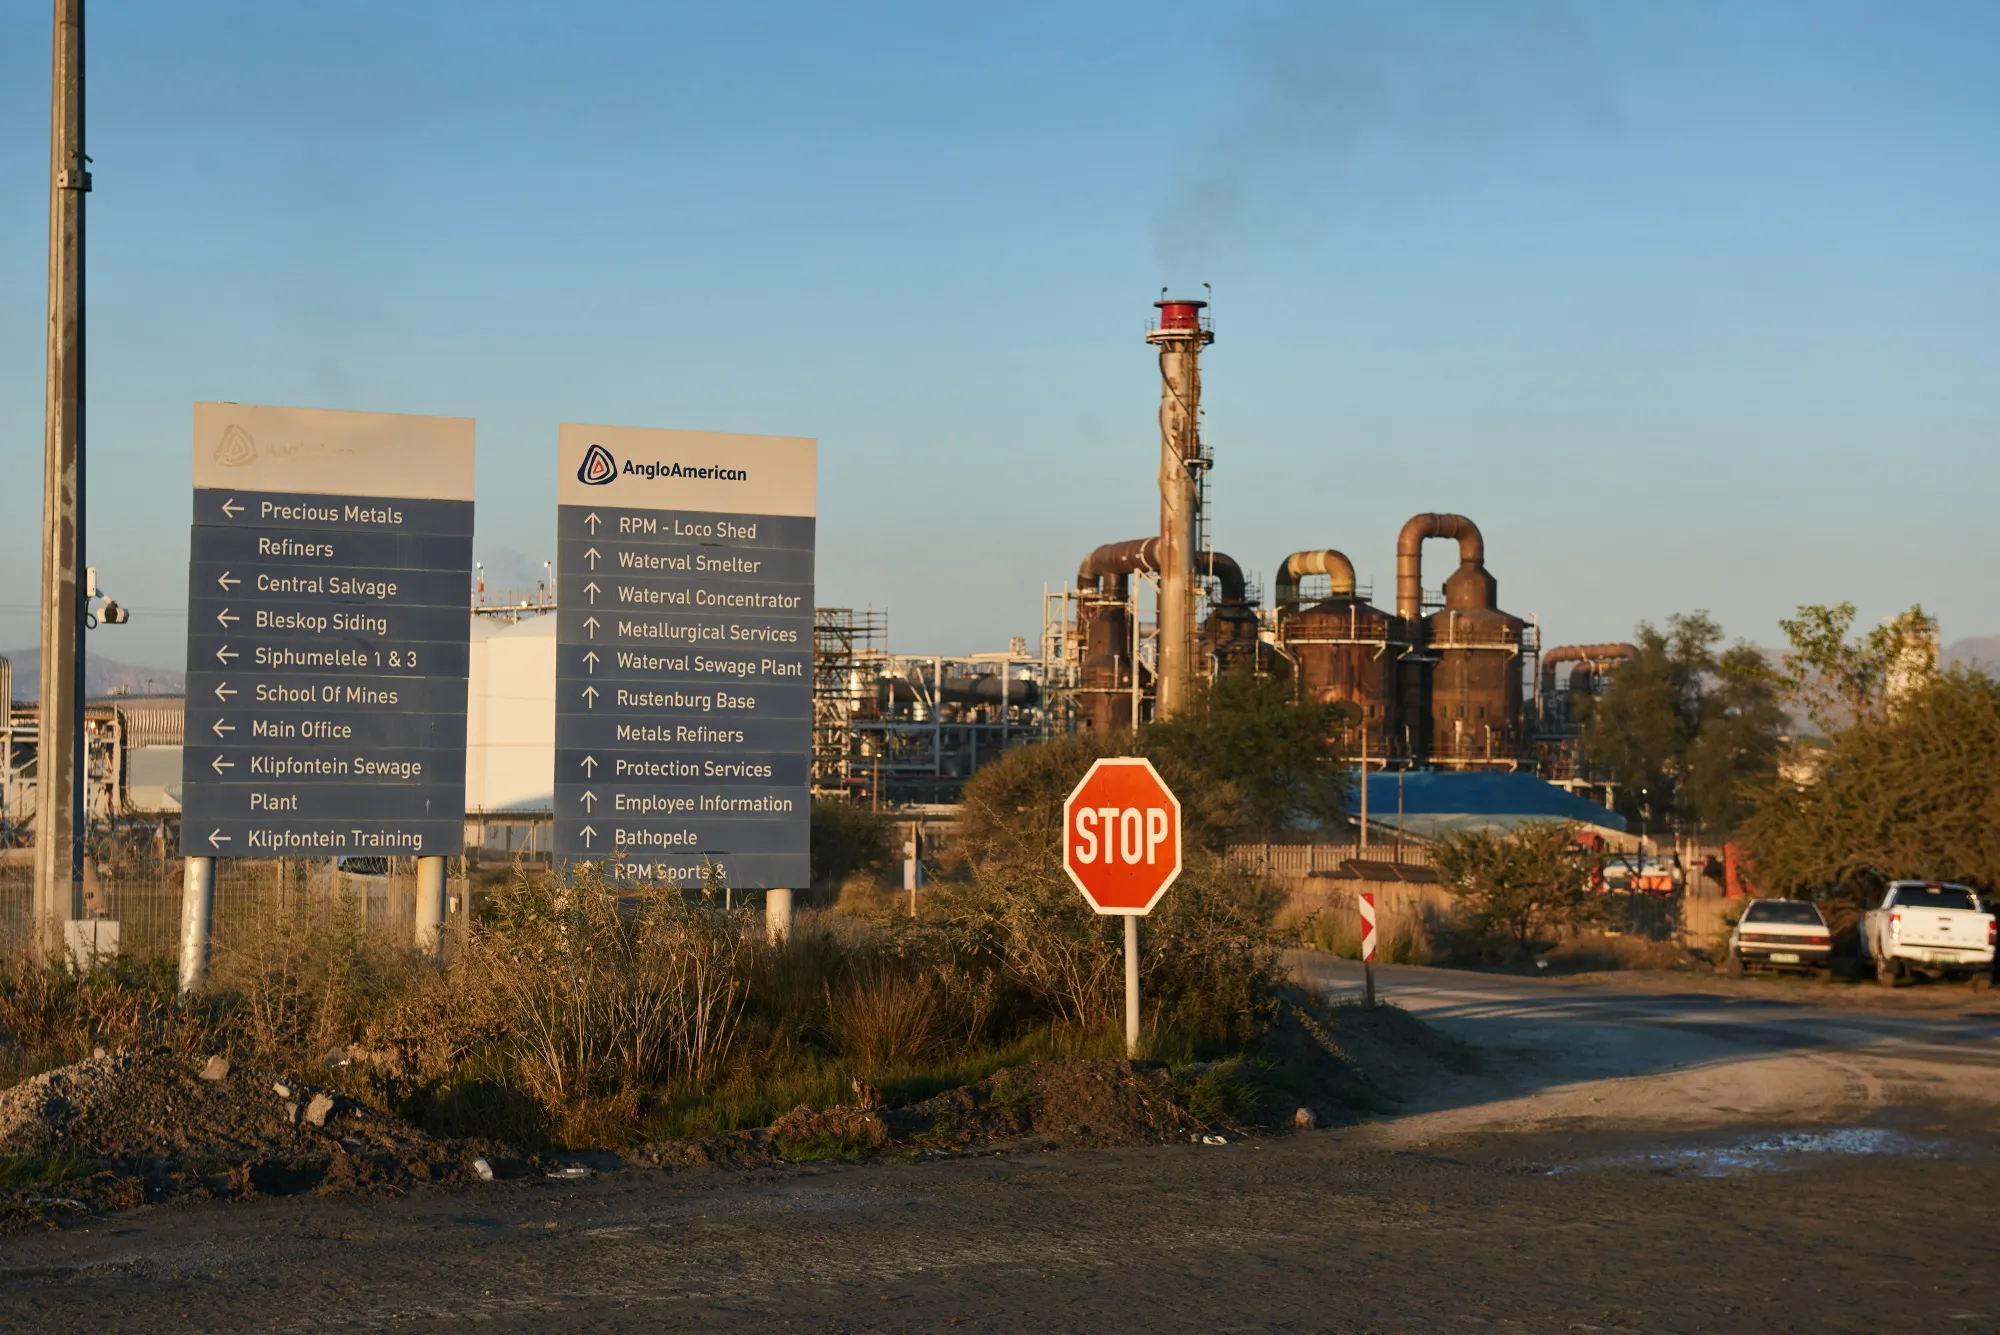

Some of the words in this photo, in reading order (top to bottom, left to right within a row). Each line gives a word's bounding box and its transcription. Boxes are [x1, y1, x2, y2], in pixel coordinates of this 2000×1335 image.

[623, 460, 746, 481] AngloAmerican
[262, 502, 338, 521] Precious
[345, 505, 402, 524] Metals
[620, 517, 656, 534] RPM
[675, 520, 711, 536] Loco
[717, 522, 756, 539] Shed
[259, 538, 333, 557] Refiners
[619, 552, 691, 570] Waterval
[696, 555, 761, 573] Smelter
[258, 574, 323, 593] Central
[329, 577, 397, 599] Salvage
[618, 586, 690, 604] Waterval
[696, 590, 800, 608] Concentrator
[257, 611, 327, 633] Bleskop
[333, 613, 386, 635] Siding
[619, 621, 725, 643] Metallurgical
[730, 625, 797, 642] Services
[256, 647, 367, 668] Siphumelele
[374, 651, 380, 666] 1
[389, 651, 401, 667] &
[407, 651, 416, 667] 3
[617, 652, 689, 671] Waterval
[695, 656, 756, 677] Sewage
[762, 659, 802, 676] Plant
[256, 684, 316, 702] School
[323, 686, 341, 702] Of
[347, 687, 398, 704] Mines
[618, 690, 711, 711] Rustenburg
[717, 692, 755, 709] Base
[253, 720, 295, 737] Main
[302, 721, 351, 738] Office
[617, 725, 671, 741] Metals
[677, 726, 743, 742] Refiners
[251, 756, 347, 777] Klipfontein
[354, 758, 421, 779] Sewage
[617, 760, 699, 776] Protection
[705, 761, 771, 777] Services
[251, 793, 297, 810] Plant
[616, 794, 694, 814] Employee
[700, 795, 792, 811] Information
[249, 830, 345, 851] Klipfontein
[352, 830, 422, 851] Training
[616, 829, 697, 849] Bathopele
[1076, 807, 1168, 864] STOP
[615, 863, 651, 880] RPM
[657, 863, 709, 882] Sports
